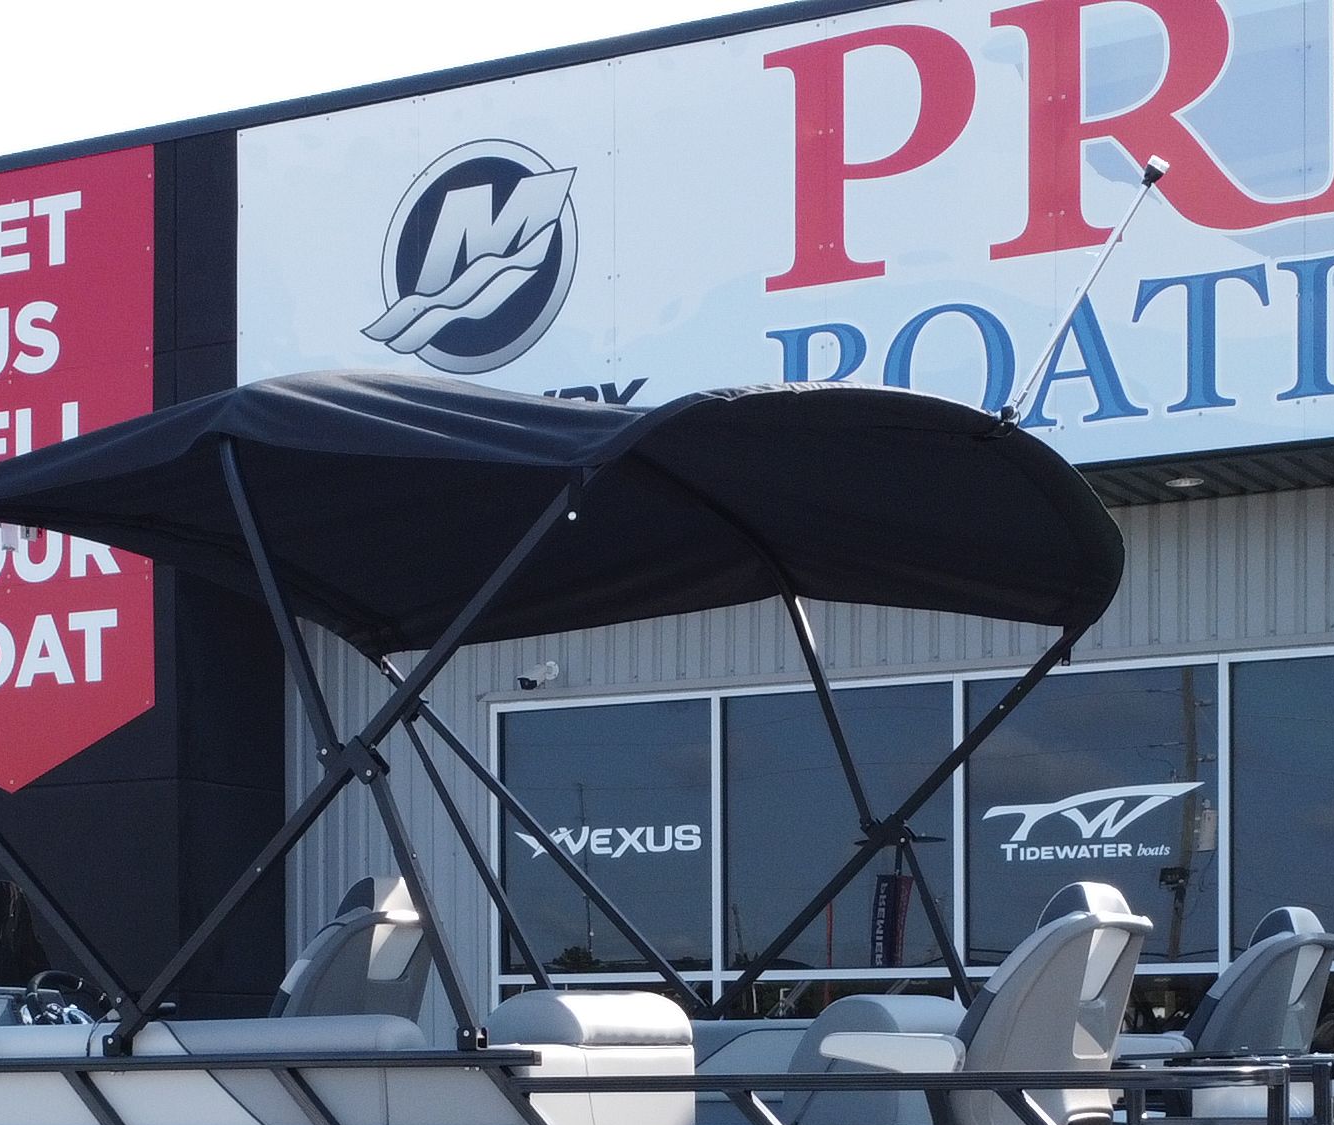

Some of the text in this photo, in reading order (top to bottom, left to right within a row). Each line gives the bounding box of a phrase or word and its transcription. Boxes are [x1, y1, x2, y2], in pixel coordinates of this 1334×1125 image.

[548, 824, 702, 858] VEXUS
[1000, 843, 1171, 862] TIDEWATER boats
